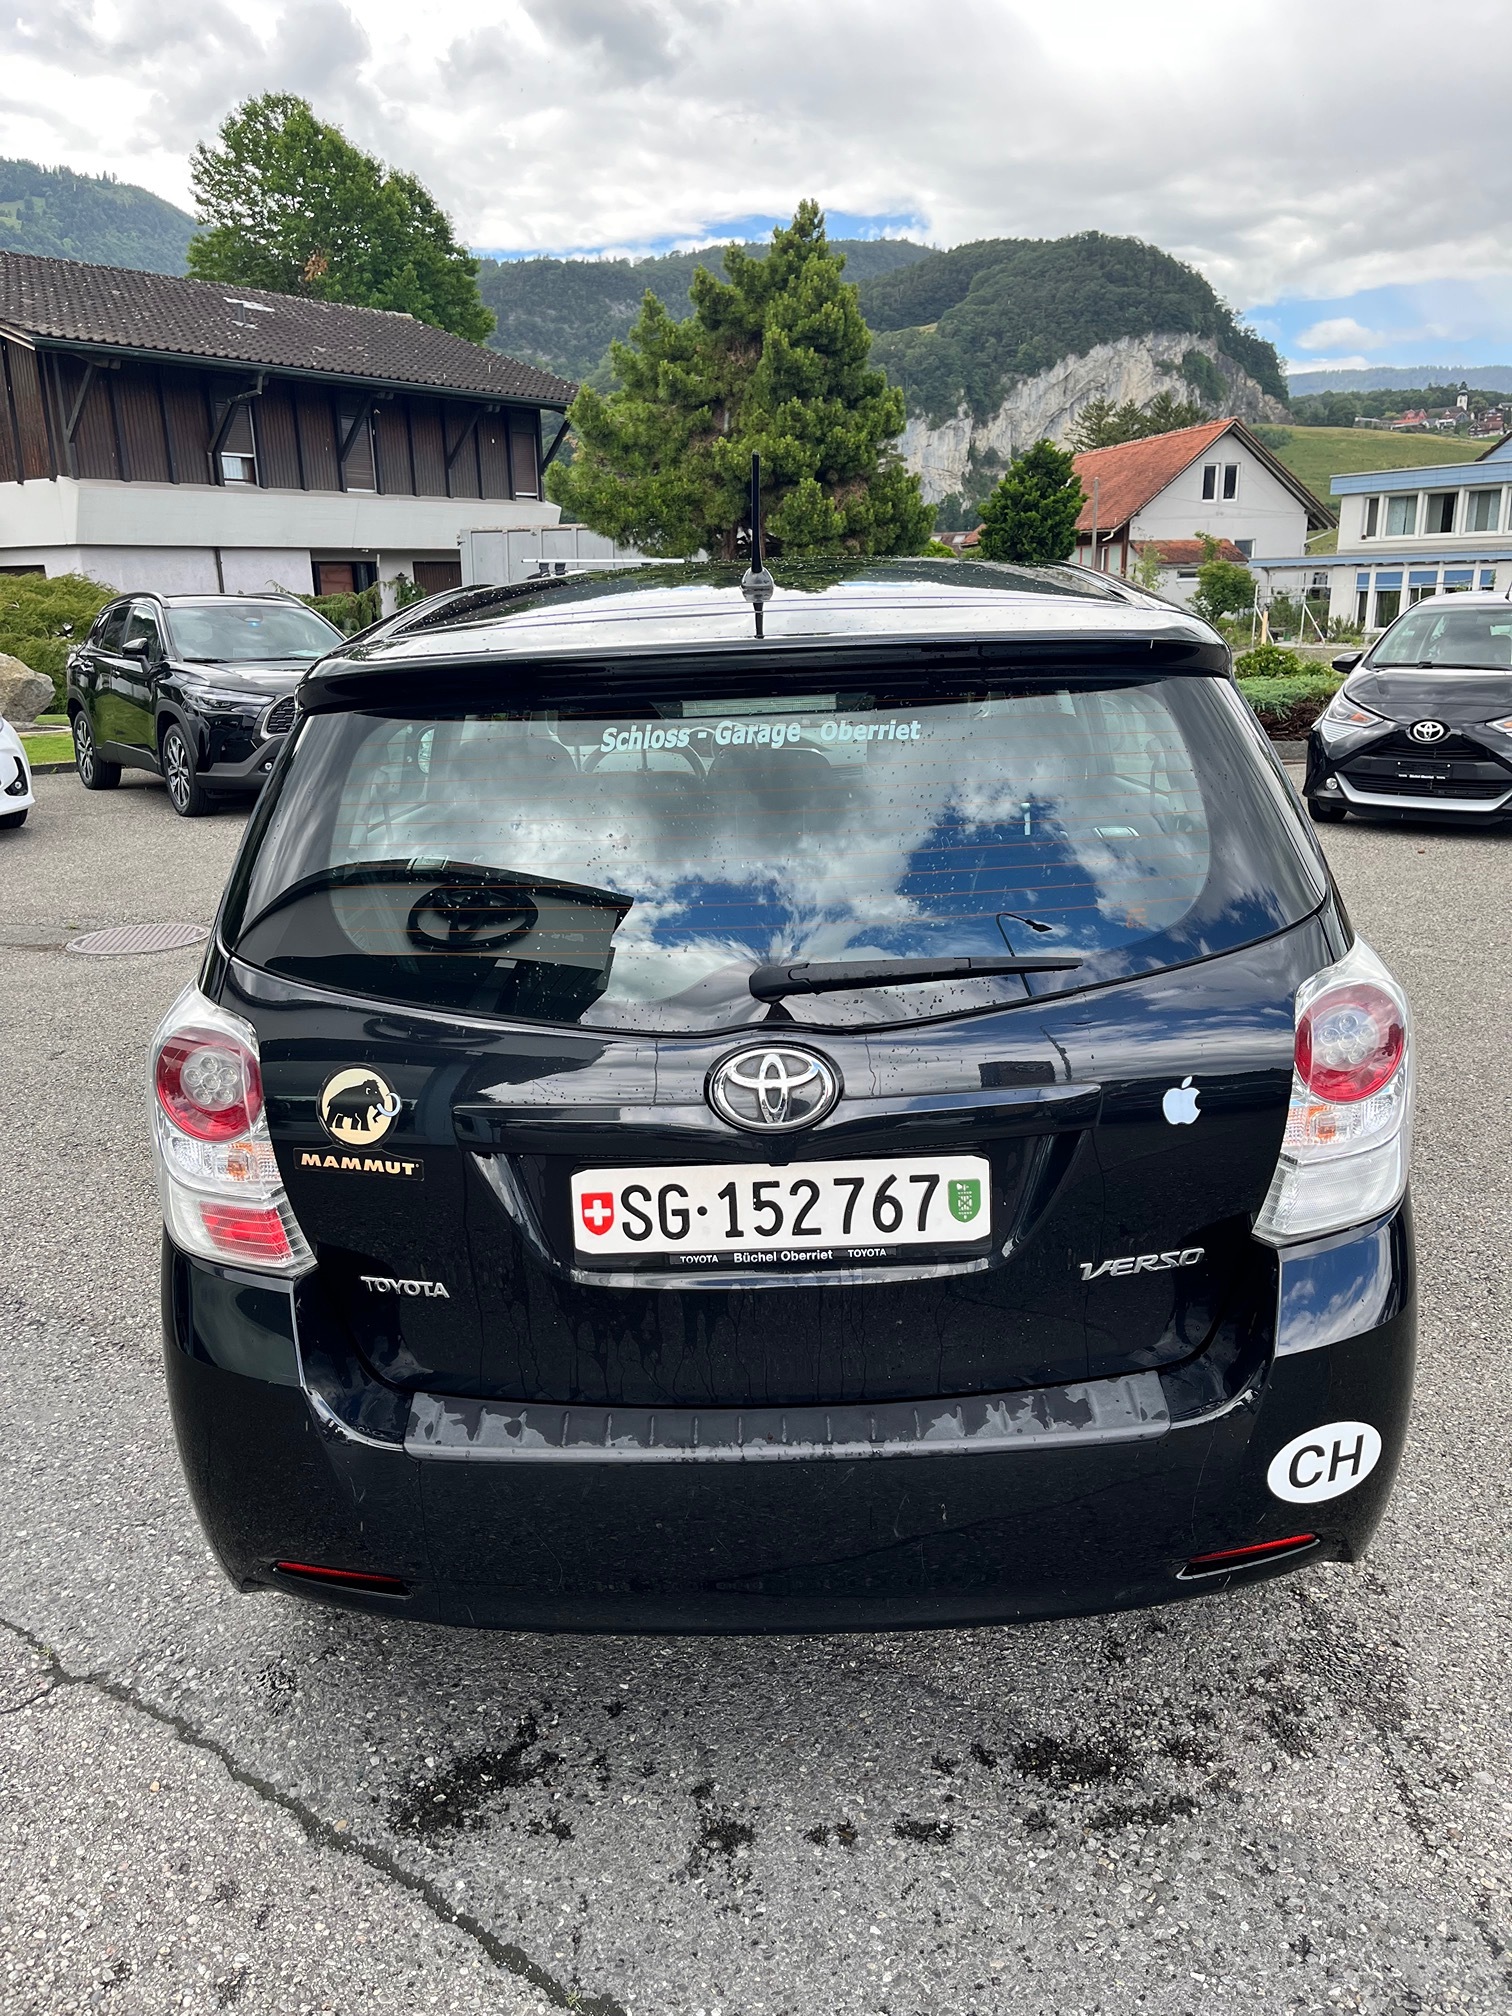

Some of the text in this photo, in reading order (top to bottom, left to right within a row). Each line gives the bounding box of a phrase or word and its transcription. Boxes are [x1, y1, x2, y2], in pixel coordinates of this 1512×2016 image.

[600, 724, 690, 752] Schloss
[714, 720, 801, 749] Garage
[819, 720, 921, 742] Oberriet
[301, 1153, 416, 1176] MAMMUT
[680, 1248, 887, 1264] TOYOTA Büchel Oberriet TOYOTA
[1079, 1247, 1205, 1281] VERSO
[360, 1275, 451, 1299] TOYOTA
[1288, 1434, 1365, 1489] CH
